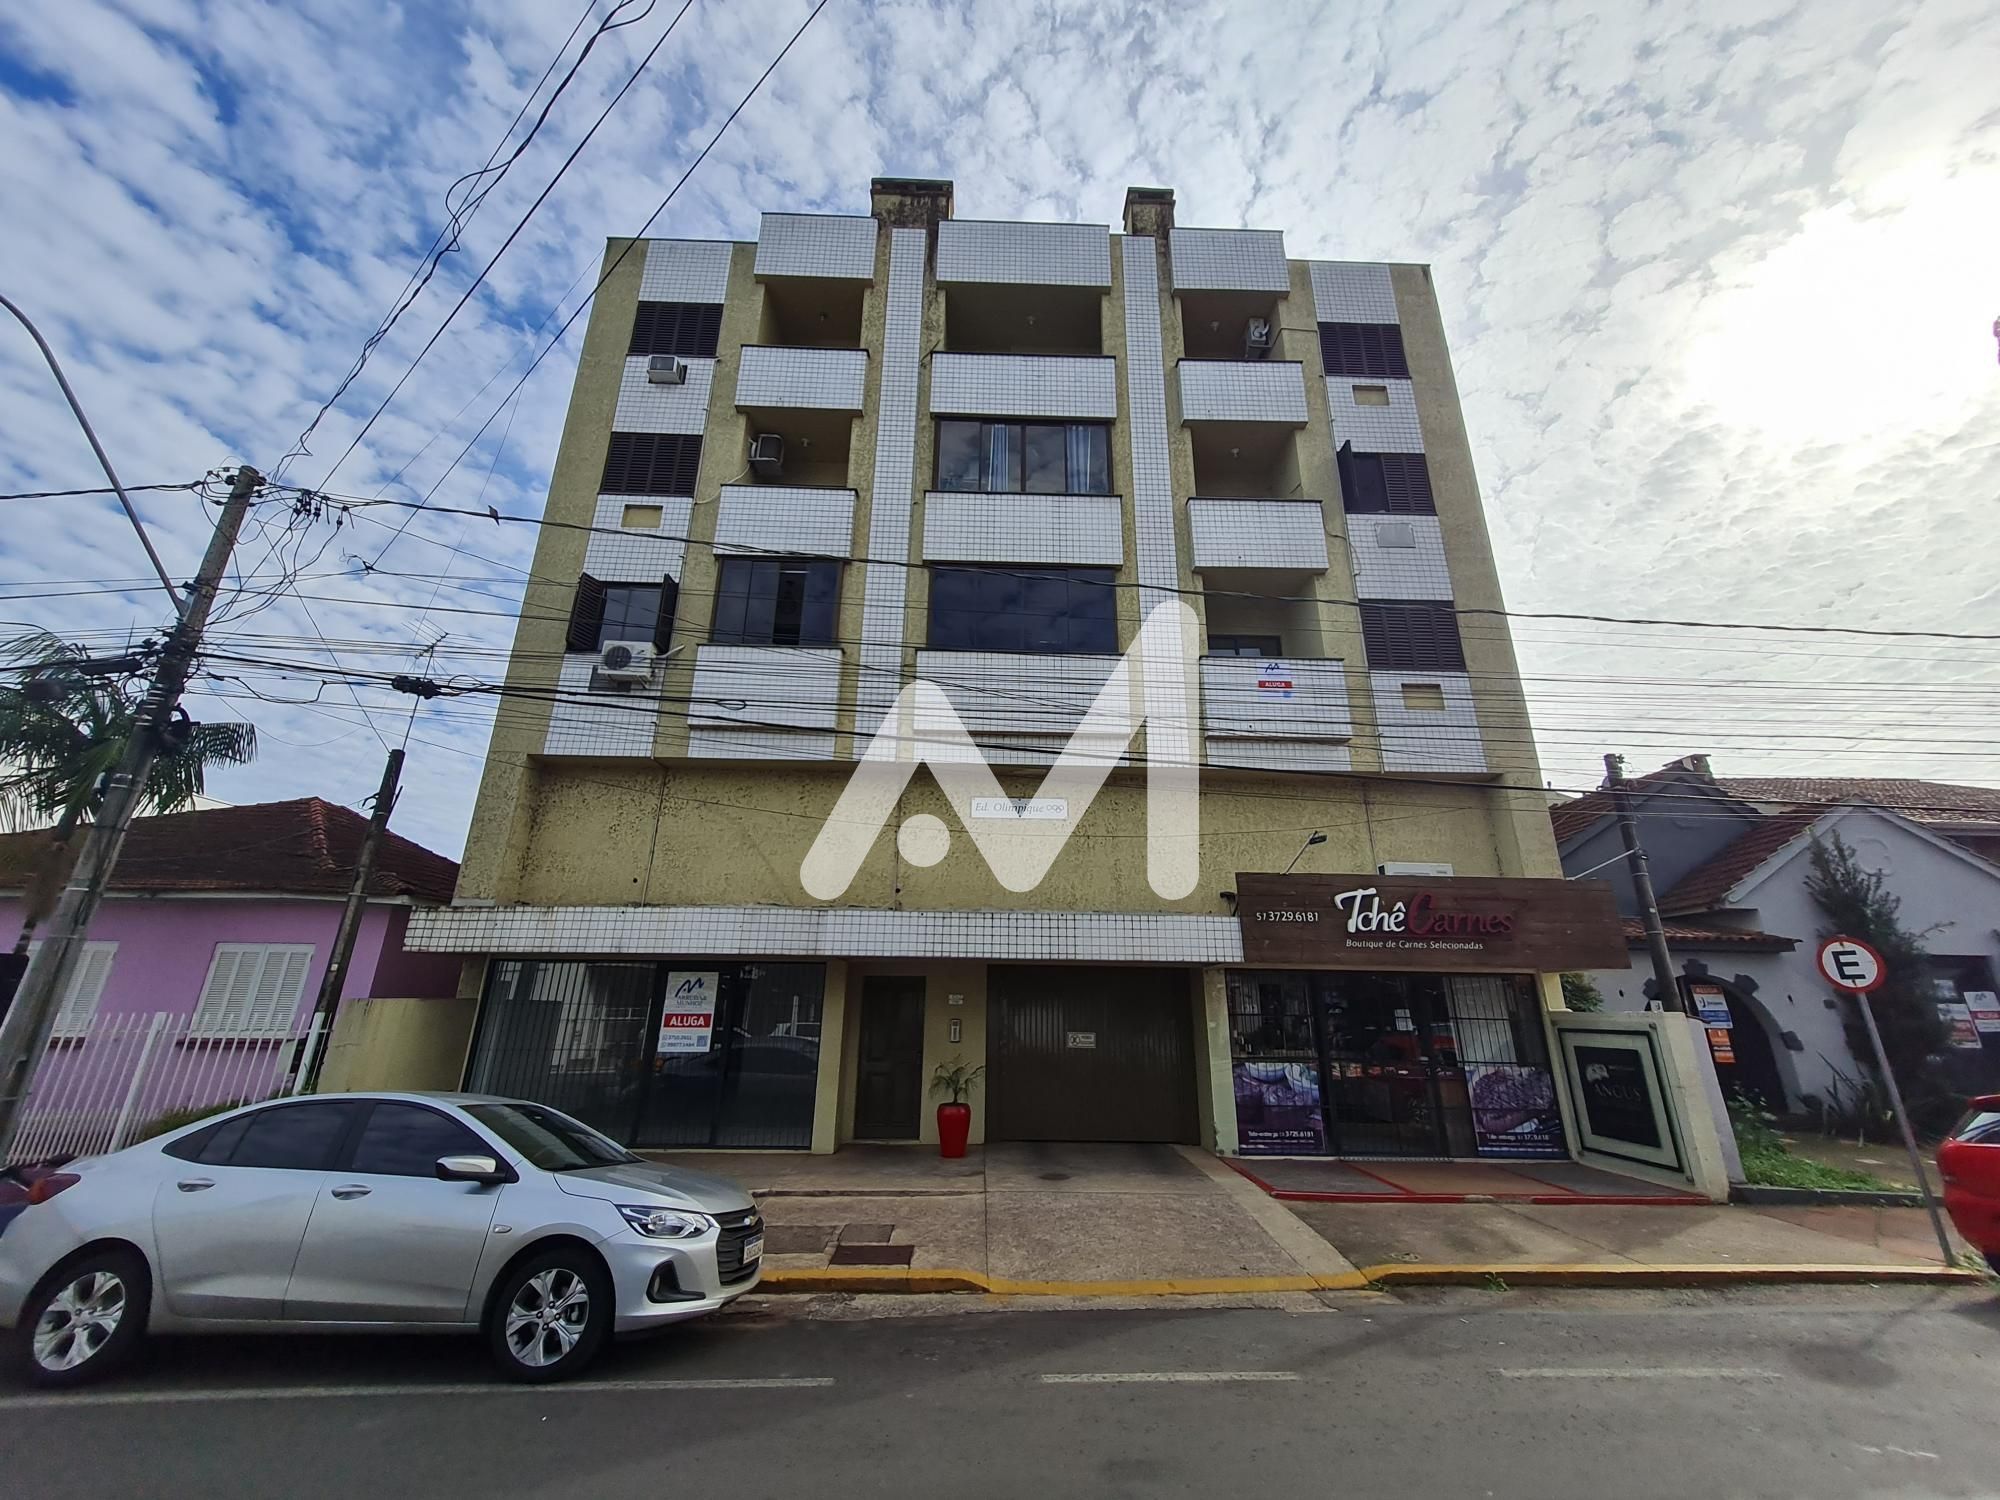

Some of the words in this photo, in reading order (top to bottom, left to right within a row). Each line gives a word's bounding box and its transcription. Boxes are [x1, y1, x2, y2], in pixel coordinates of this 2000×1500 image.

[993, 802, 1045, 815] Olimpique
[1268, 911, 1319, 923] 3729.6181
[1334, 887, 1407, 934] Tchê
[1408, 890, 1514, 935] Carnes
[1346, 938, 1384, 950] Boutique
[1386, 939, 1396, 948] de
[1399, 939, 1428, 949] Carnes
[1430, 940, 1484, 951] Selecionadas
[1831, 950, 1867, 980] E
[669, 1015, 705, 1026] ALUGA
